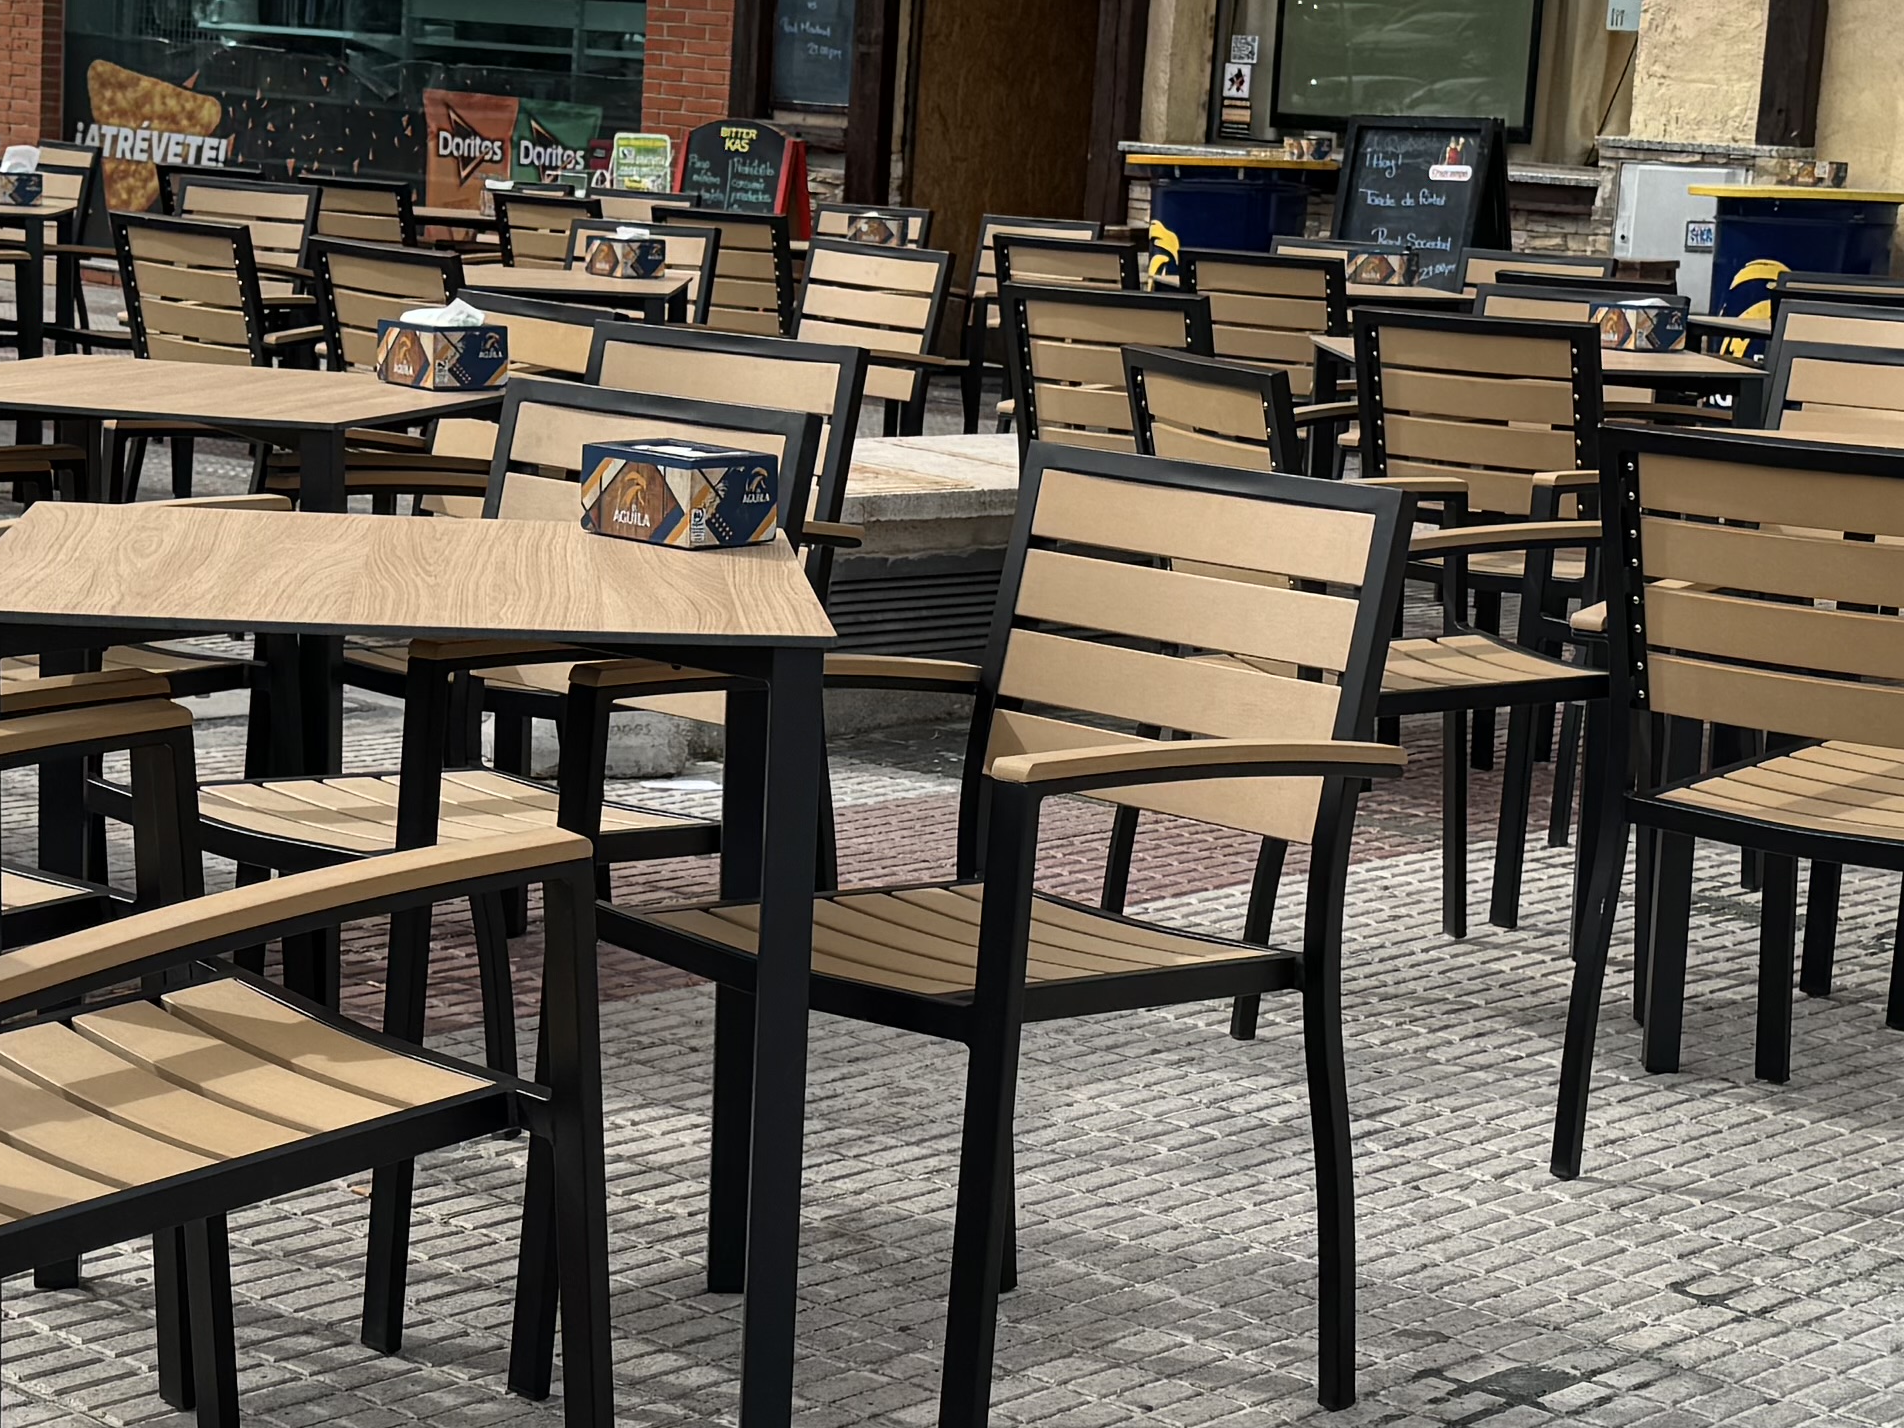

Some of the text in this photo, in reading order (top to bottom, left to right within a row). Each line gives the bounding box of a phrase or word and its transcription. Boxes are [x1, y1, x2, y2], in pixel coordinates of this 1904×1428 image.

[75, 120, 229, 168] ¡ATRÉVETE!
[438, 131, 503, 162] Doritos
[720, 126, 758, 140] BITTER
[724, 138, 750, 152] KAS
[519, 140, 585, 171] Doritos
